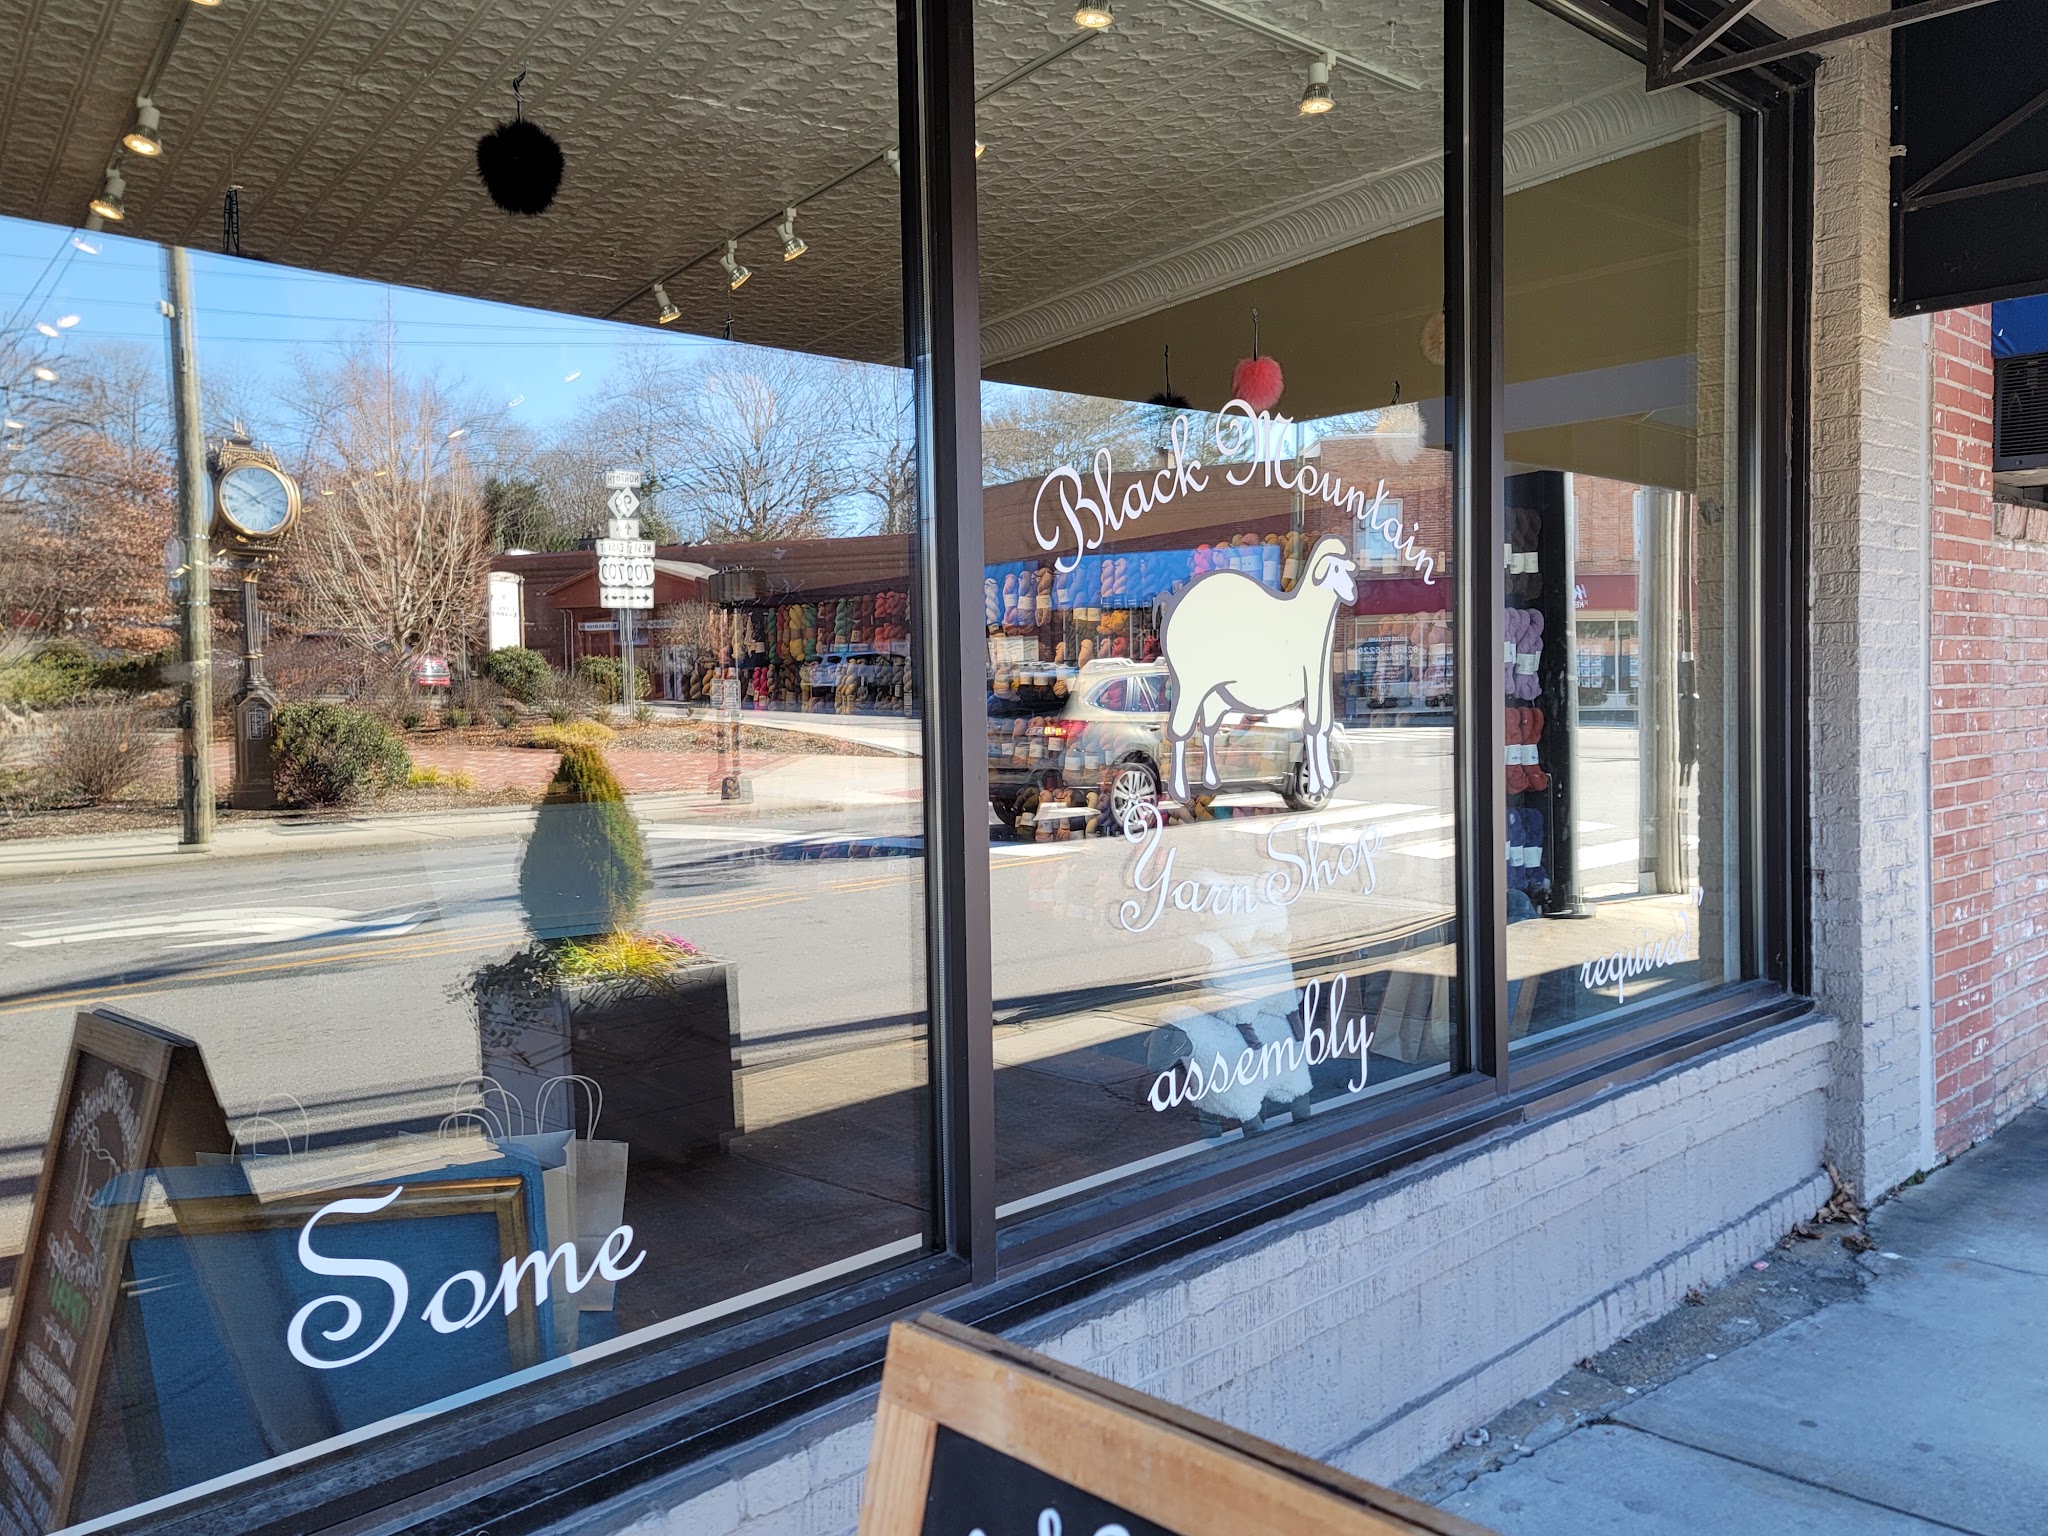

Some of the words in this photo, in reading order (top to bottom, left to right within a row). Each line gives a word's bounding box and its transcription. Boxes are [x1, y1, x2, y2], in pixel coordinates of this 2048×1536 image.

[1033, 414, 1209, 573] Black
[1215, 399, 1435, 586] Mountain
[1120, 802, 1259, 933] Yarn
[1266, 819, 1383, 907] Shop
[287, 1185, 647, 1369] Some
[1147, 972, 1375, 1112] assembly
